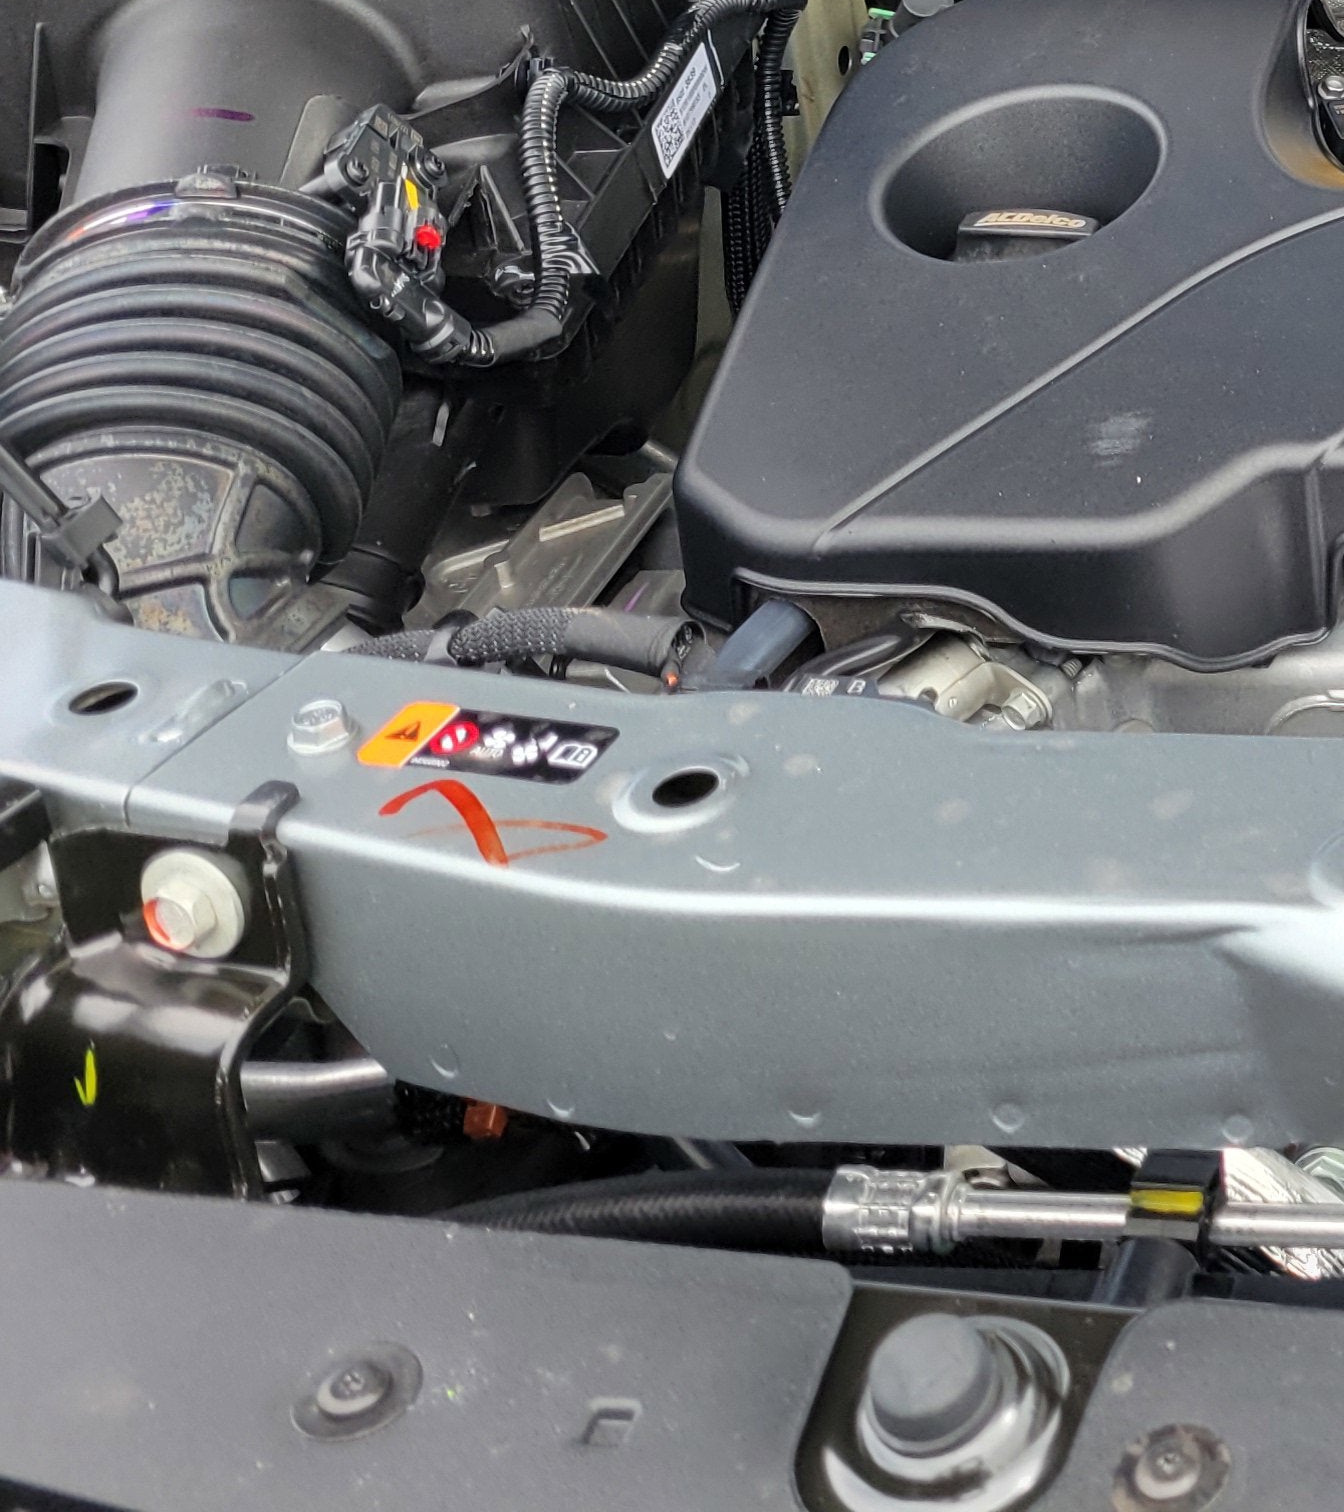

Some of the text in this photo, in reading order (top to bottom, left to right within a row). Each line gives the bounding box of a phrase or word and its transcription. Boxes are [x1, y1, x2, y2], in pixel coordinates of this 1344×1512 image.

[974, 212, 1086, 228] ACDelco
[847, 679, 866, 694] B
[469, 746, 504, 759] AUTO
